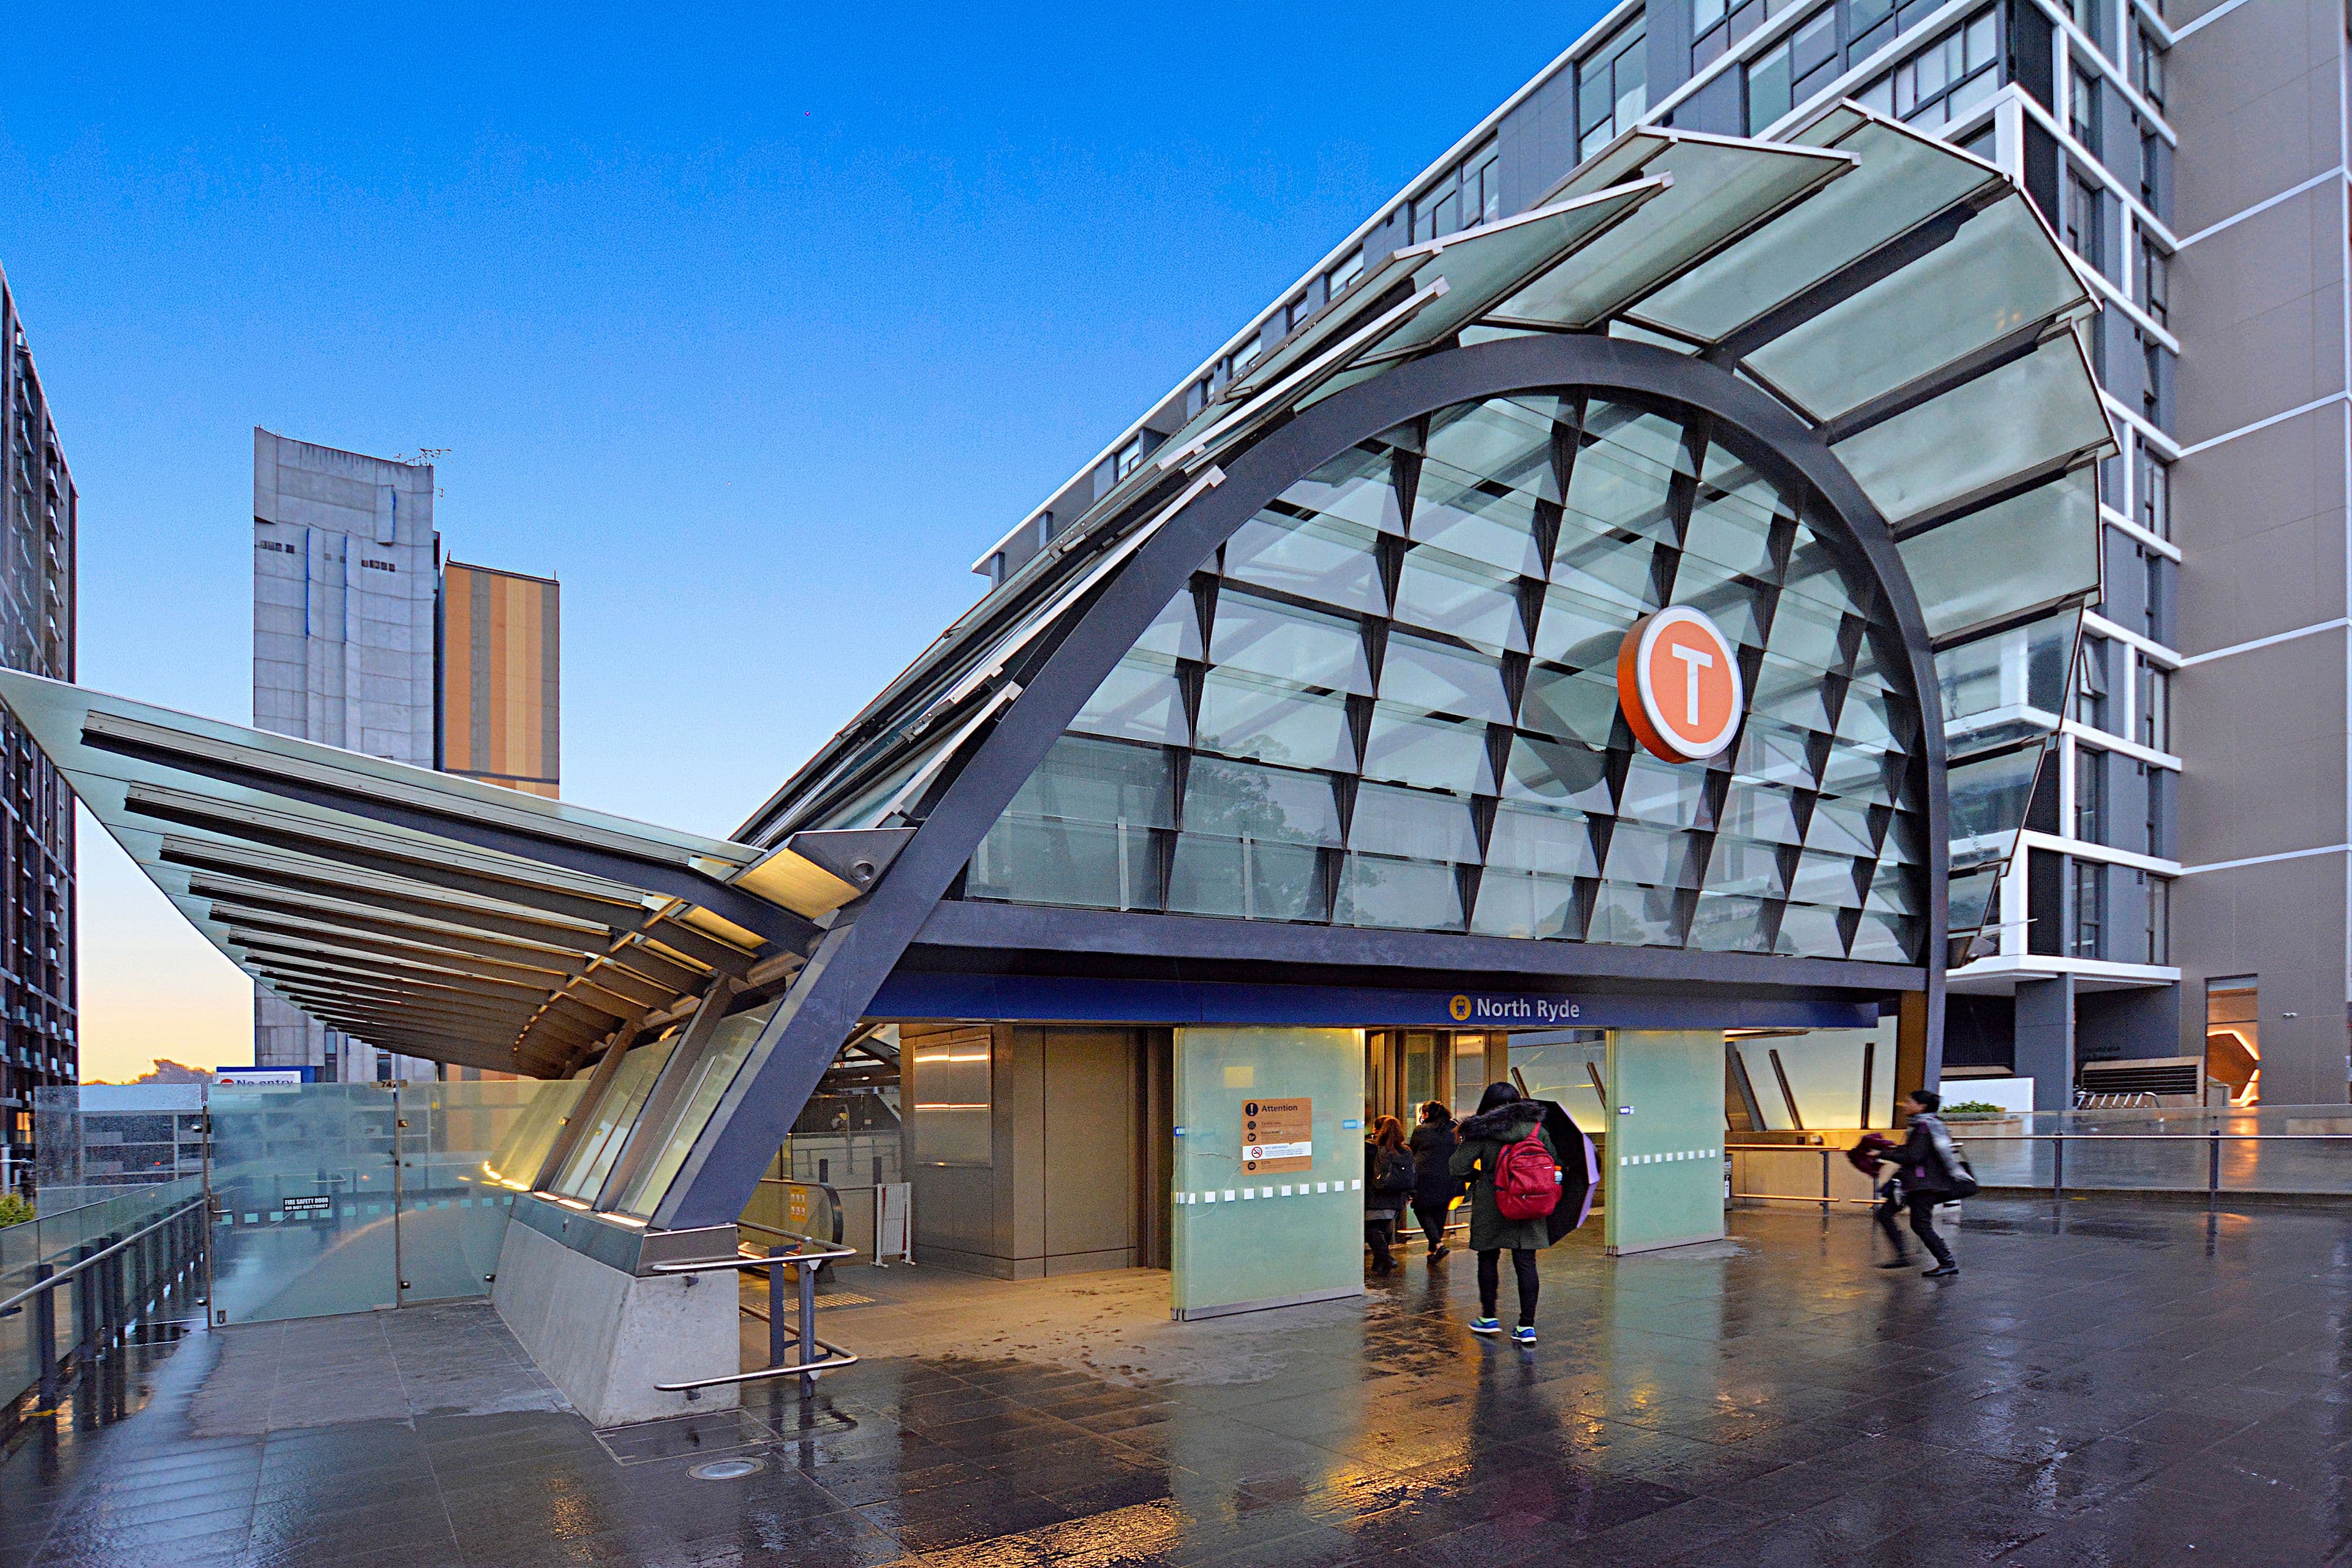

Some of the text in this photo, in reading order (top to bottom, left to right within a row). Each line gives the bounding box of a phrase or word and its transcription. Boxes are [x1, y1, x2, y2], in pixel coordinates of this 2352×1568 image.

[1672, 643, 1713, 726] T
[1477, 998, 1580, 1022] North Ryde
